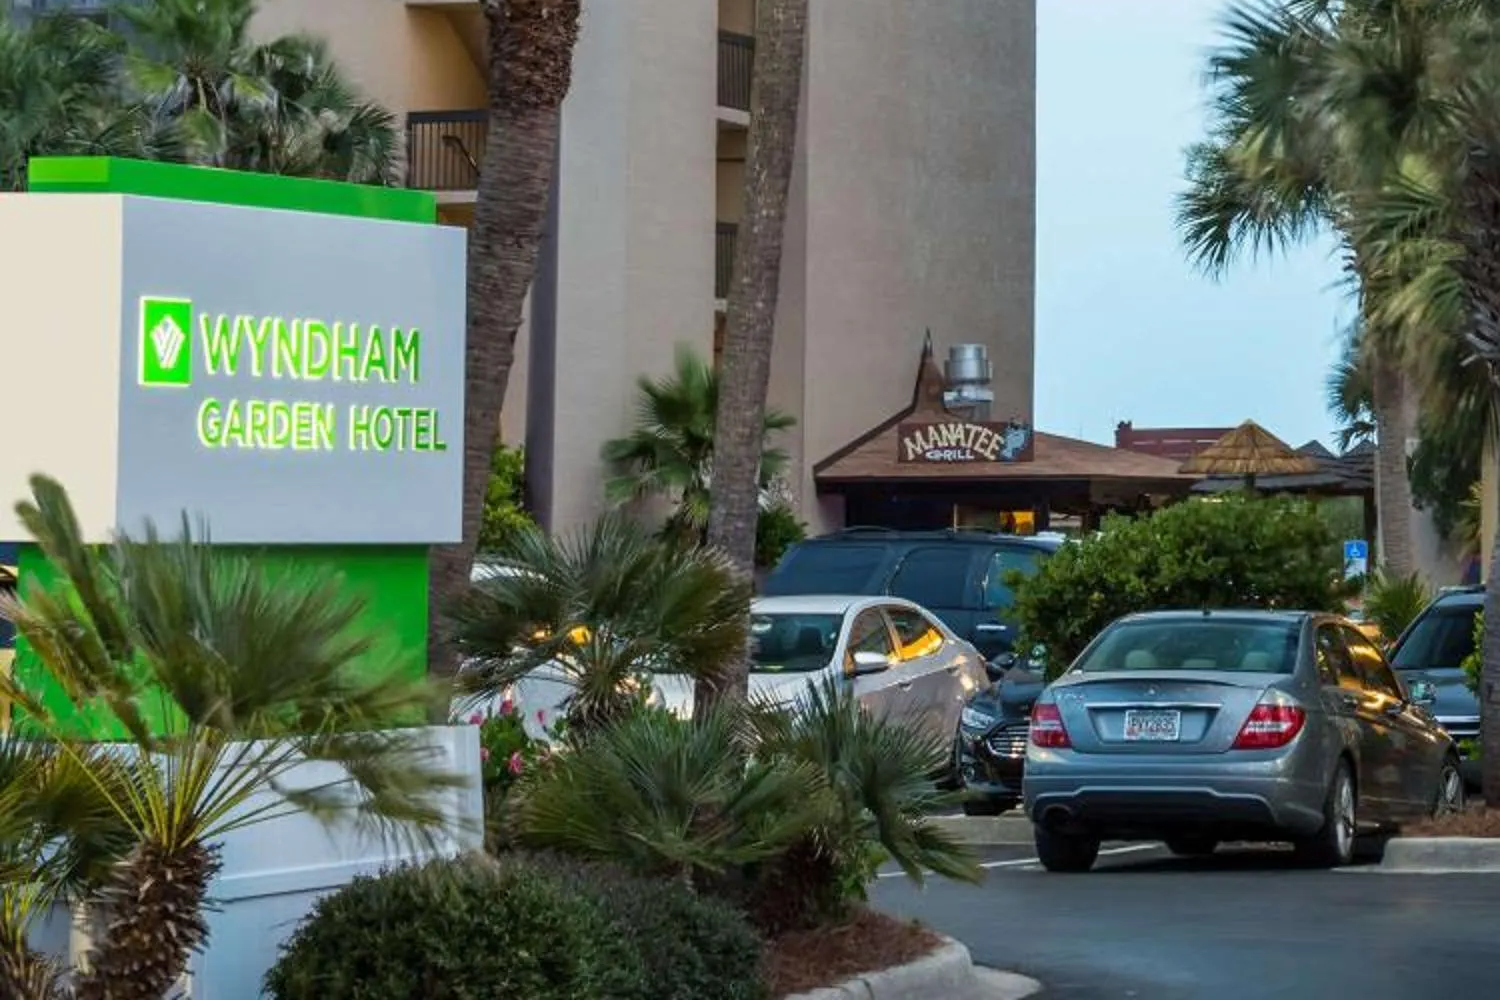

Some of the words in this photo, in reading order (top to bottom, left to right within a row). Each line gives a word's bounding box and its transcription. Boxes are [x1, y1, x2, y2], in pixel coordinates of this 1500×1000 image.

[199, 312, 420, 383] WYNDHAM
[197, 397, 334, 450] GARDEN
[348, 404, 447, 451] HOTEL
[903, 423, 1005, 460] MANATEE
[925, 448, 975, 460] GRILL
